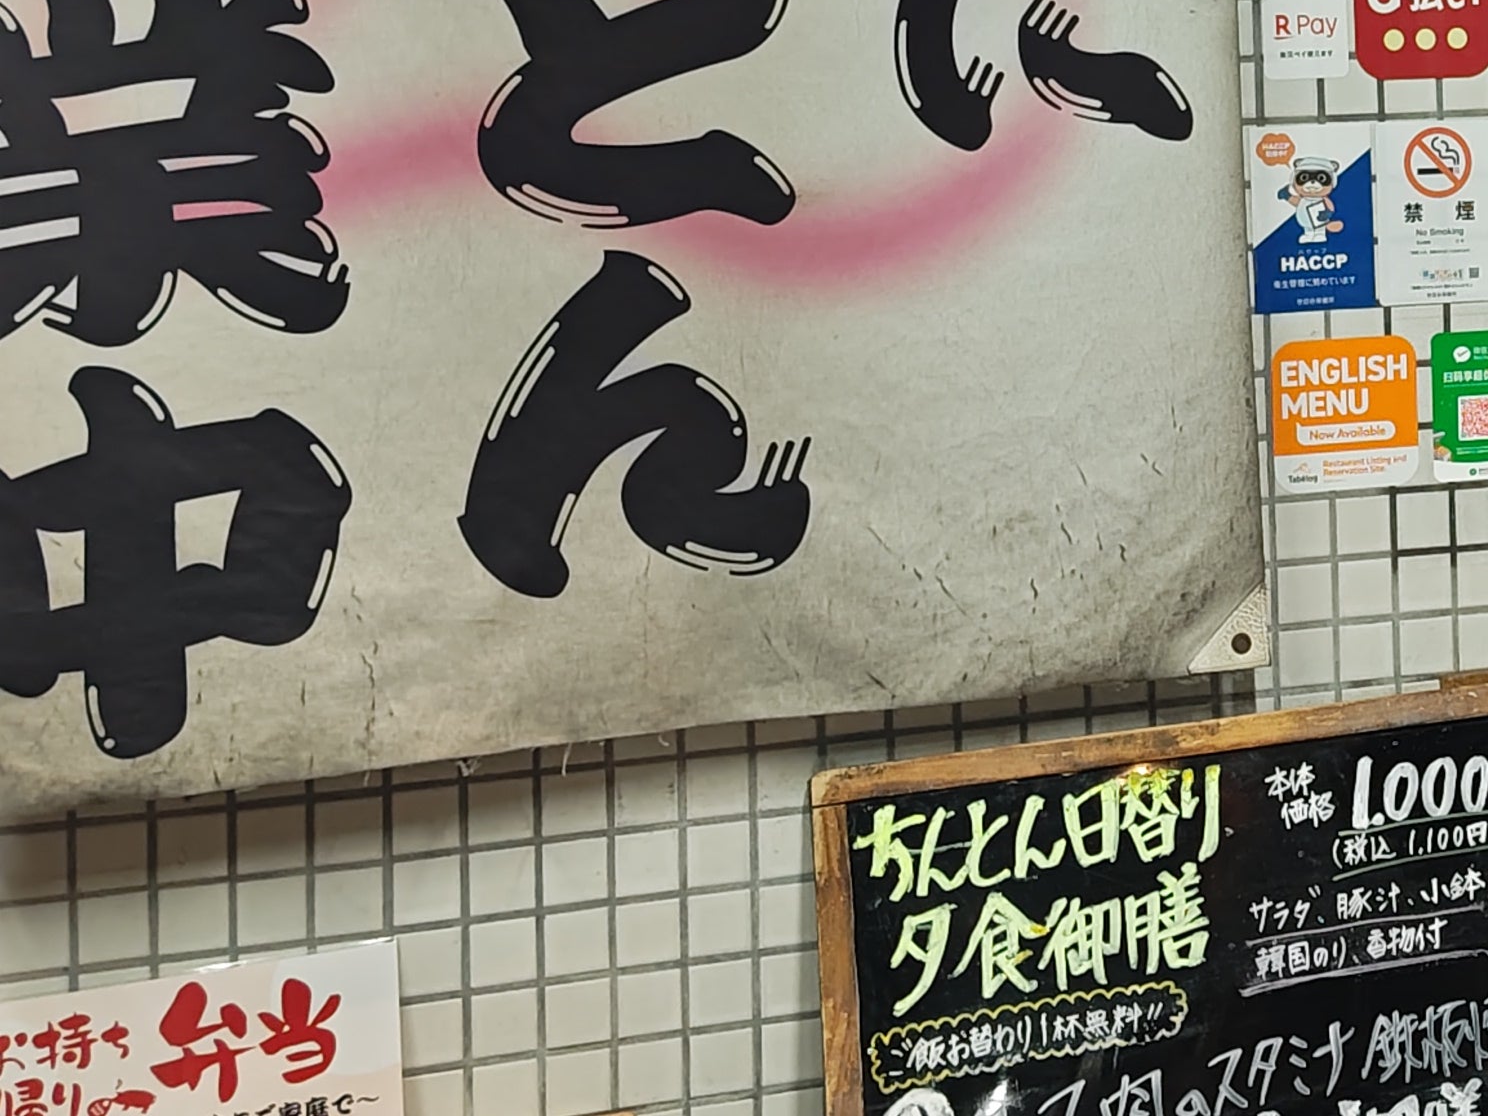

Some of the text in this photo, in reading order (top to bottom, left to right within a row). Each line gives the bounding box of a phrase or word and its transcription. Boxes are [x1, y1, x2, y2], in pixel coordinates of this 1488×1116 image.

[1281, 253, 1348, 272] HACCP
[1280, 354, 1407, 387] ENGLISH
[1281, 388, 1369, 420] MENU
[1309, 425, 1386, 441] Now Available
[1323, 457, 1364, 468] Restaurant
[1264, 762, 1315, 801] 本体
[1280, 791, 1336, 829] 価格
[853, 764, 1221, 902] ちんとん日替り
[890, 861, 1211, 1018] 夕食御膳
[150, 977, 342, 1103] 弁当
